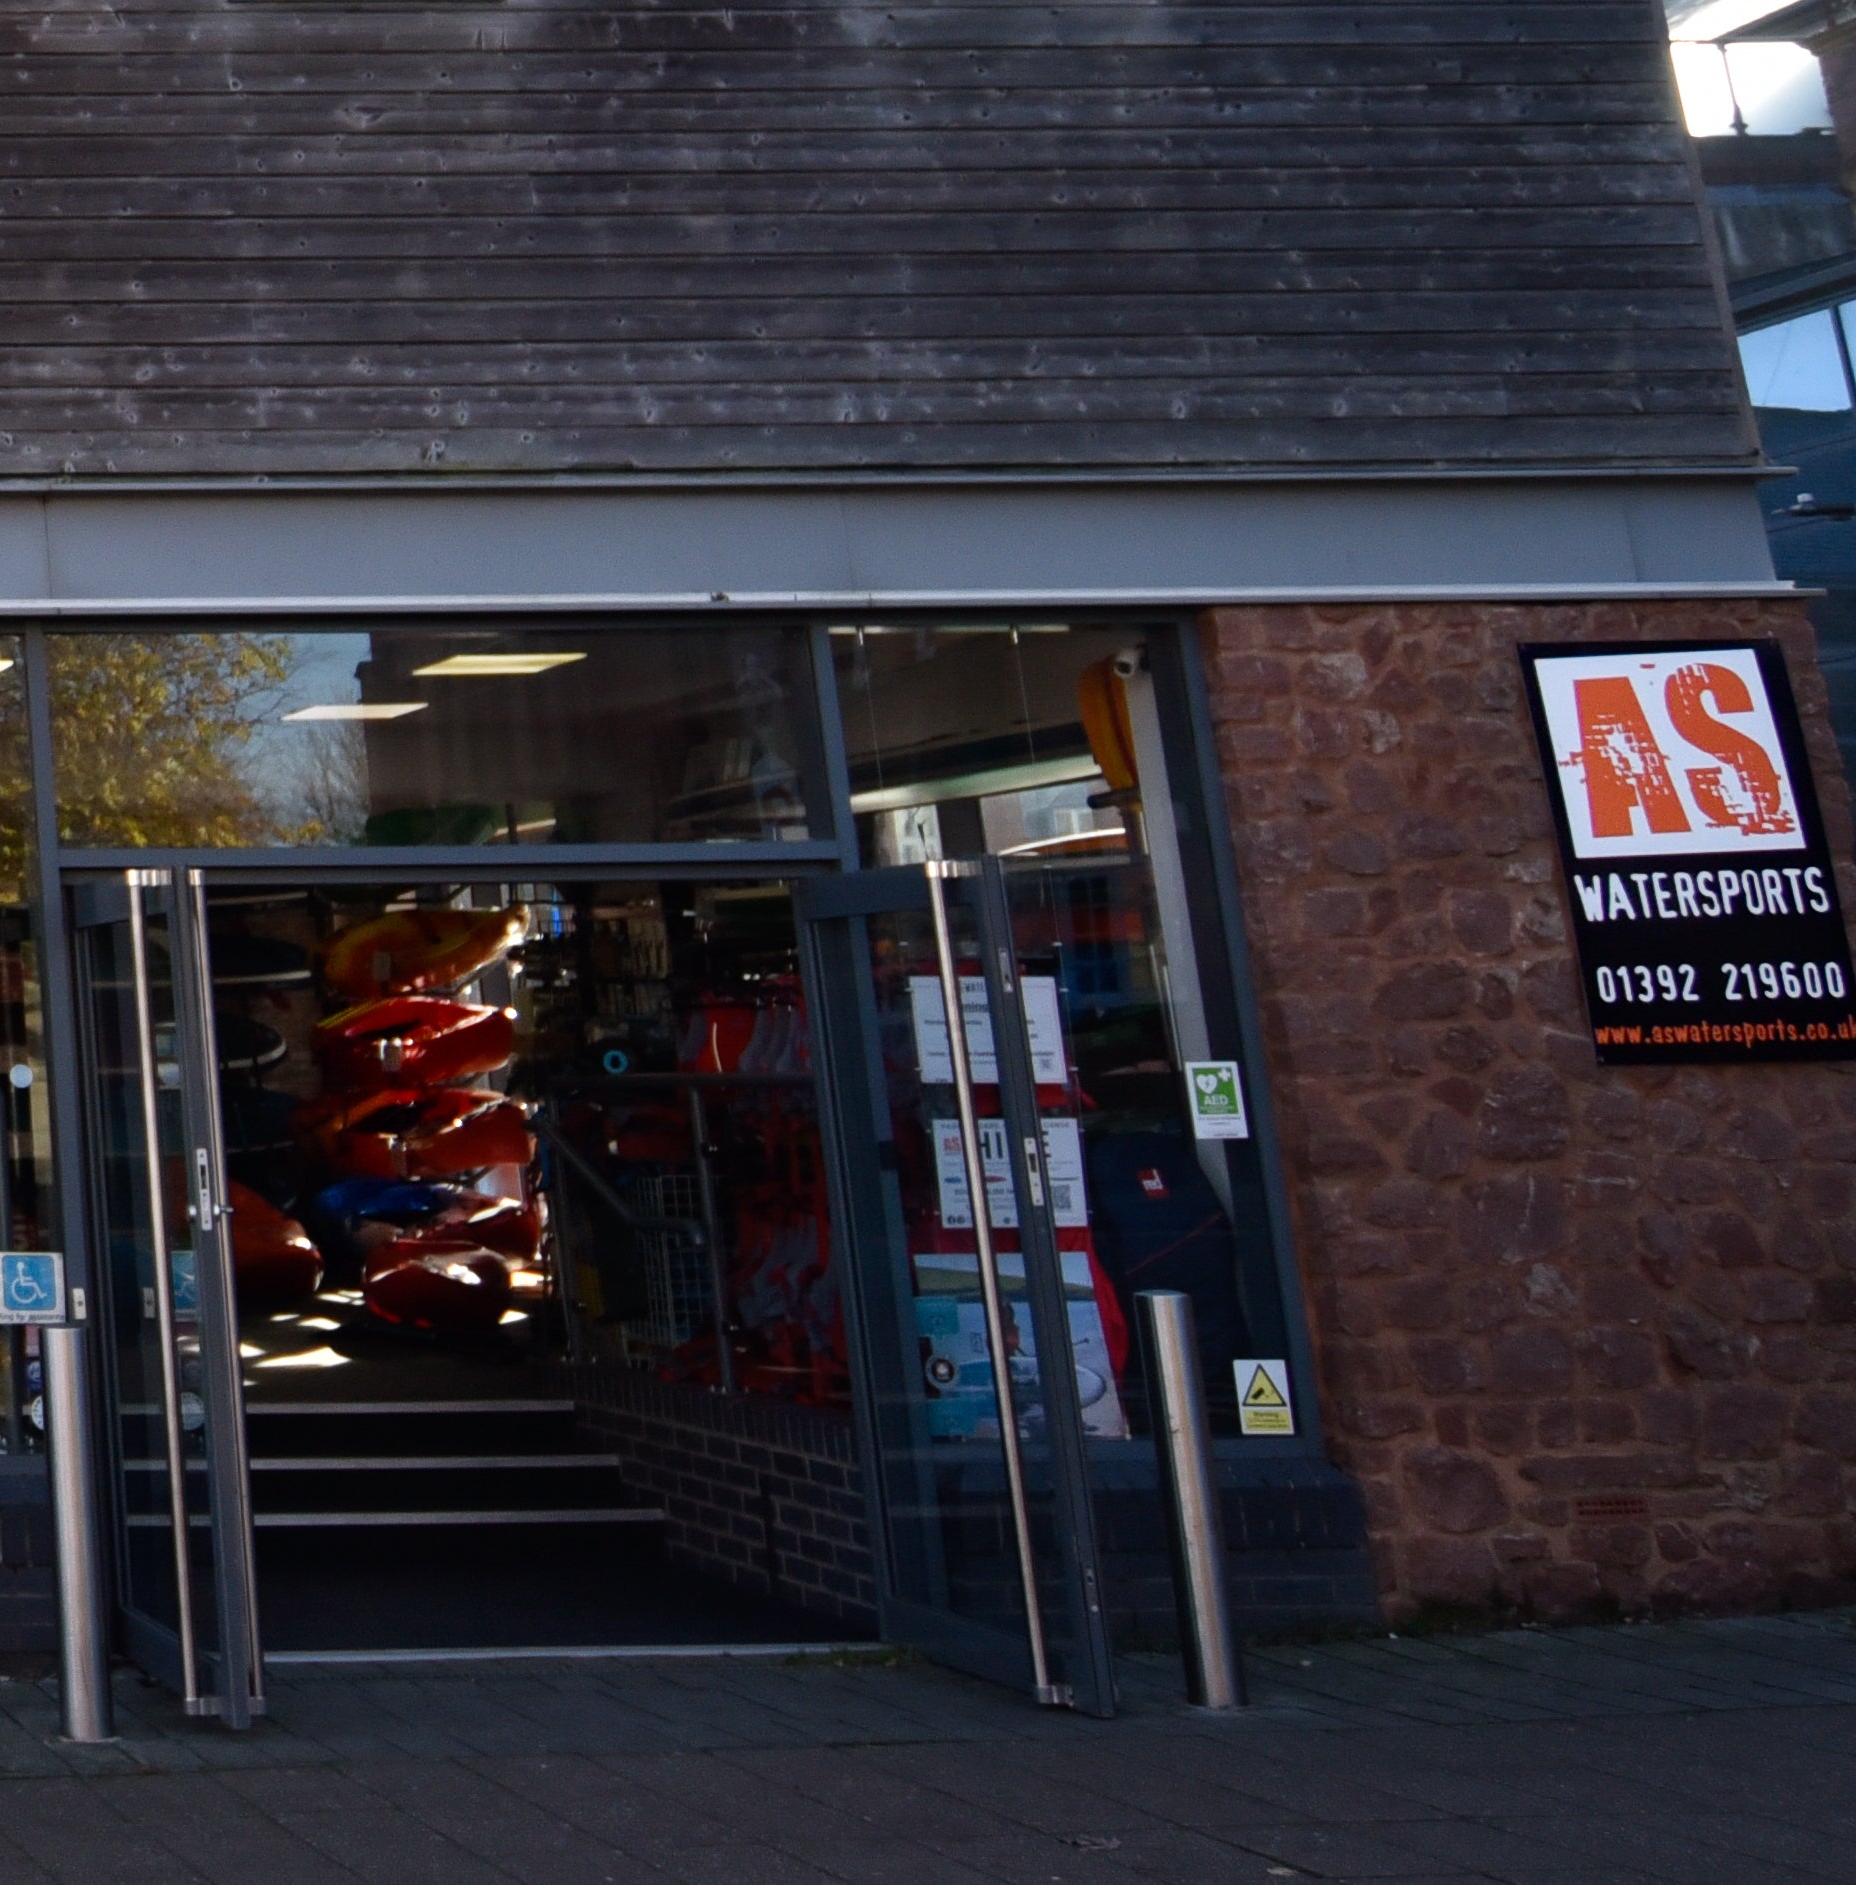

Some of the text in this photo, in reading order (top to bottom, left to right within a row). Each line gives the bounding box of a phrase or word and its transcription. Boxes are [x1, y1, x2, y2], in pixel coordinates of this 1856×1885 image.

[1563, 663, 1795, 838] AS
[1573, 866, 1830, 922] WATERSPORTS
[1596, 961, 1845, 1003] 01392 219600
[1204, 1094, 1229, 1105] AED
